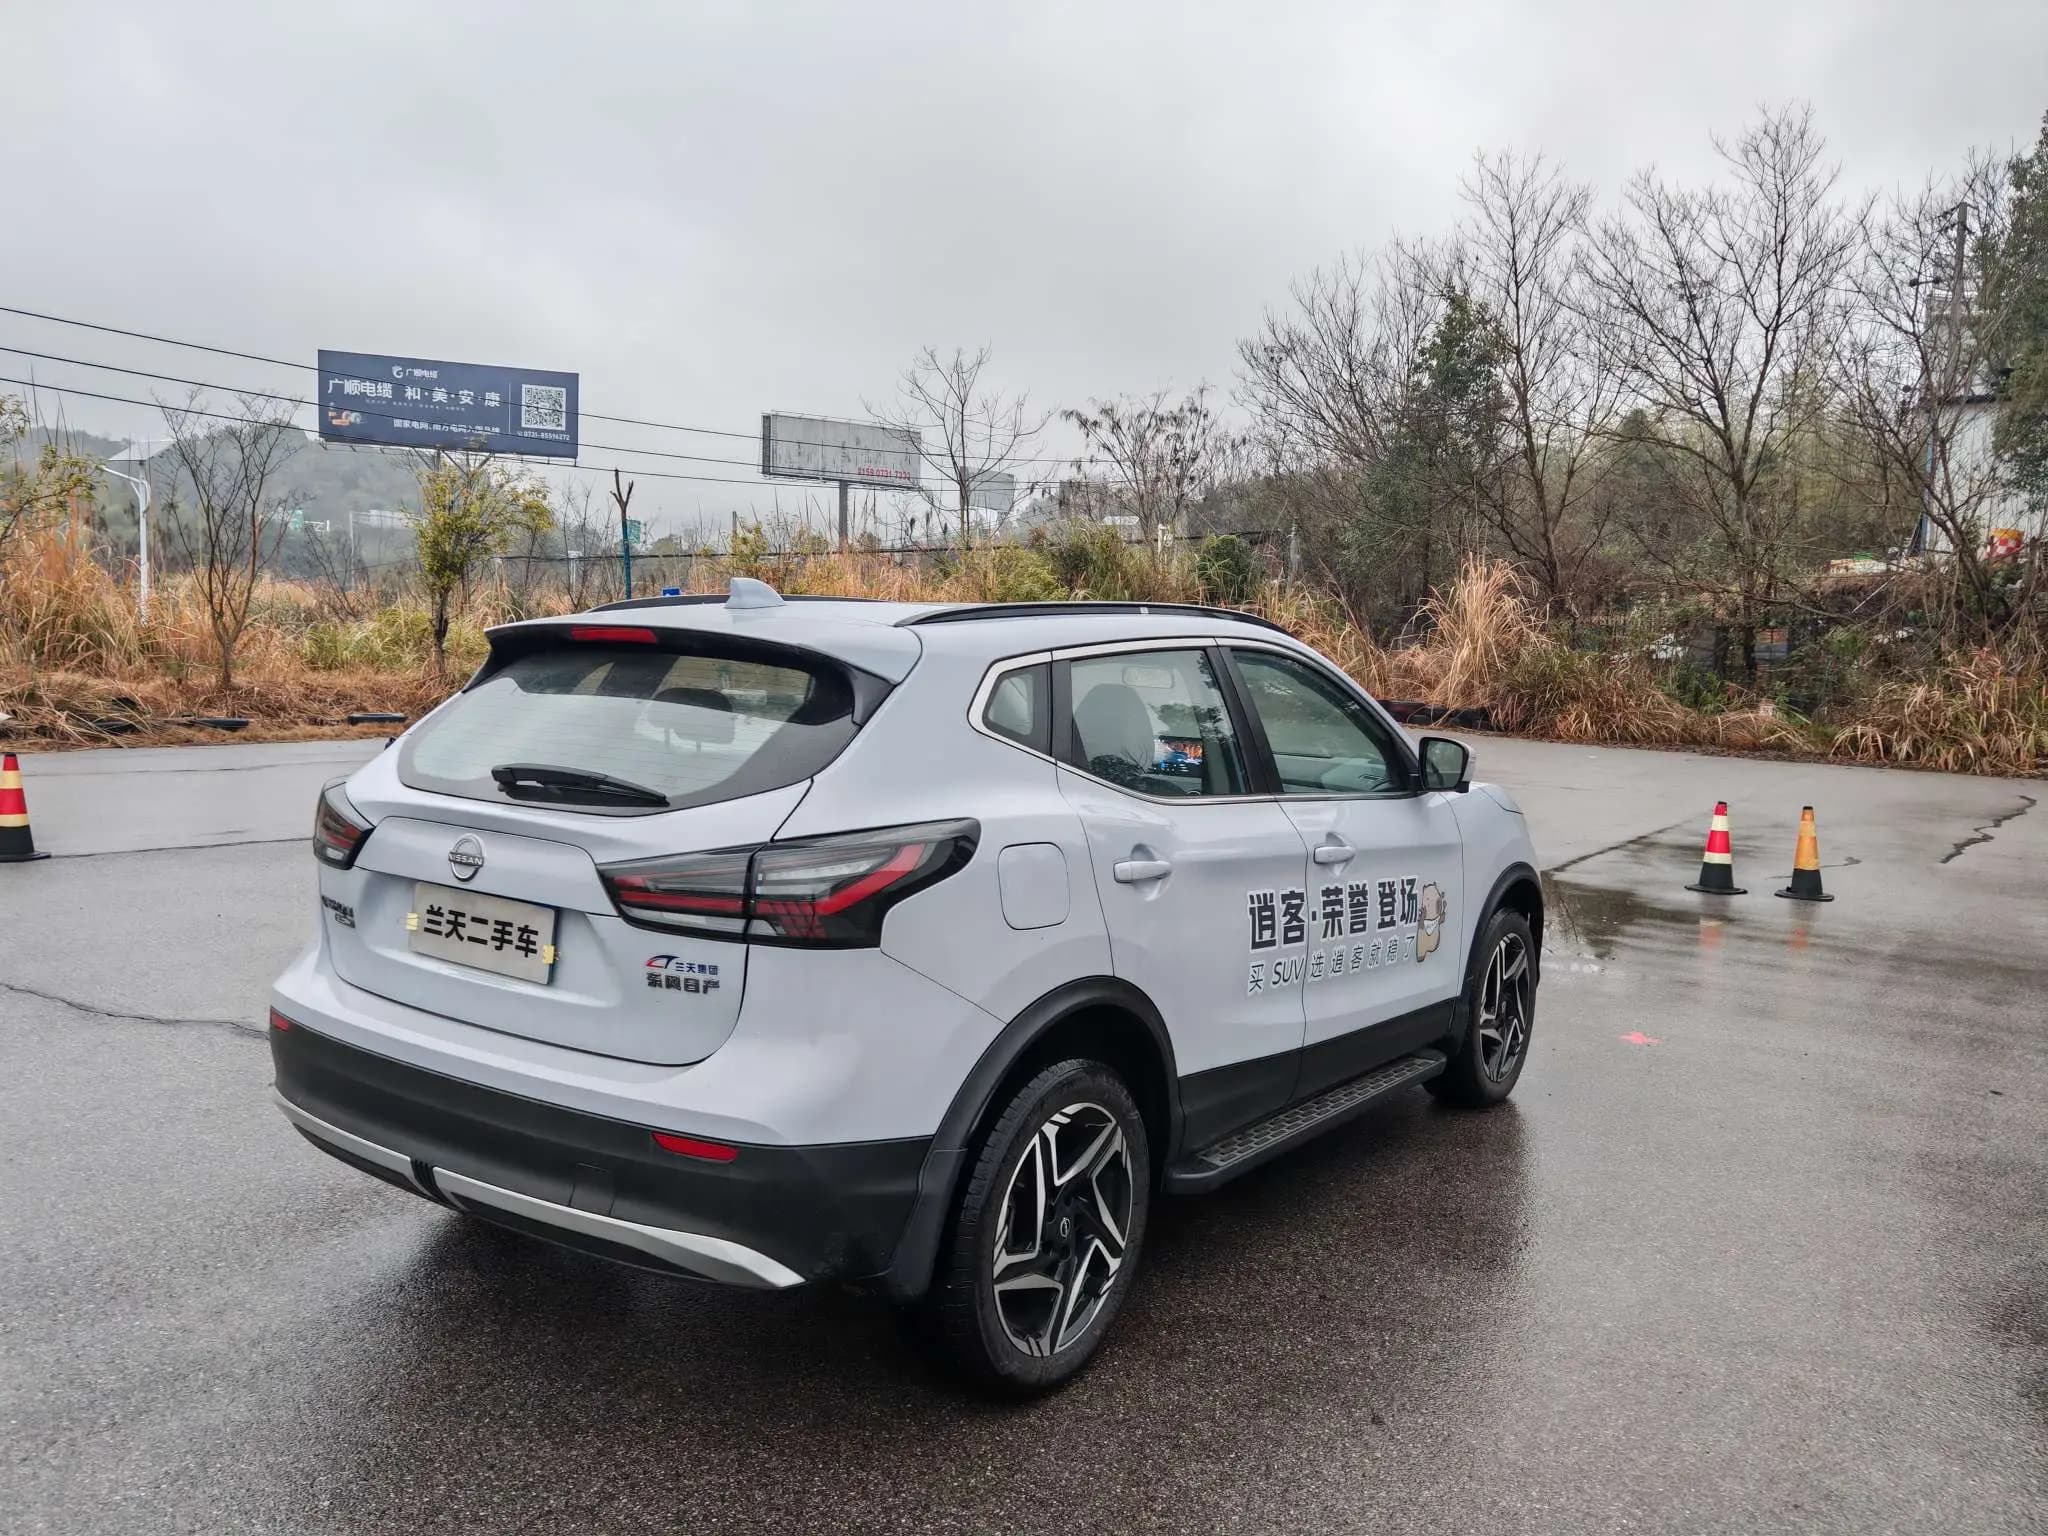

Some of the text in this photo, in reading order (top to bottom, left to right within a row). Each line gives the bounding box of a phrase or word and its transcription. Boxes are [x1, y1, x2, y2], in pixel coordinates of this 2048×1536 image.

[328, 378, 393, 399] 广顺电缆
[448, 853, 482, 865] NISSAN
[423, 904, 539, 958] 兰天二手车
